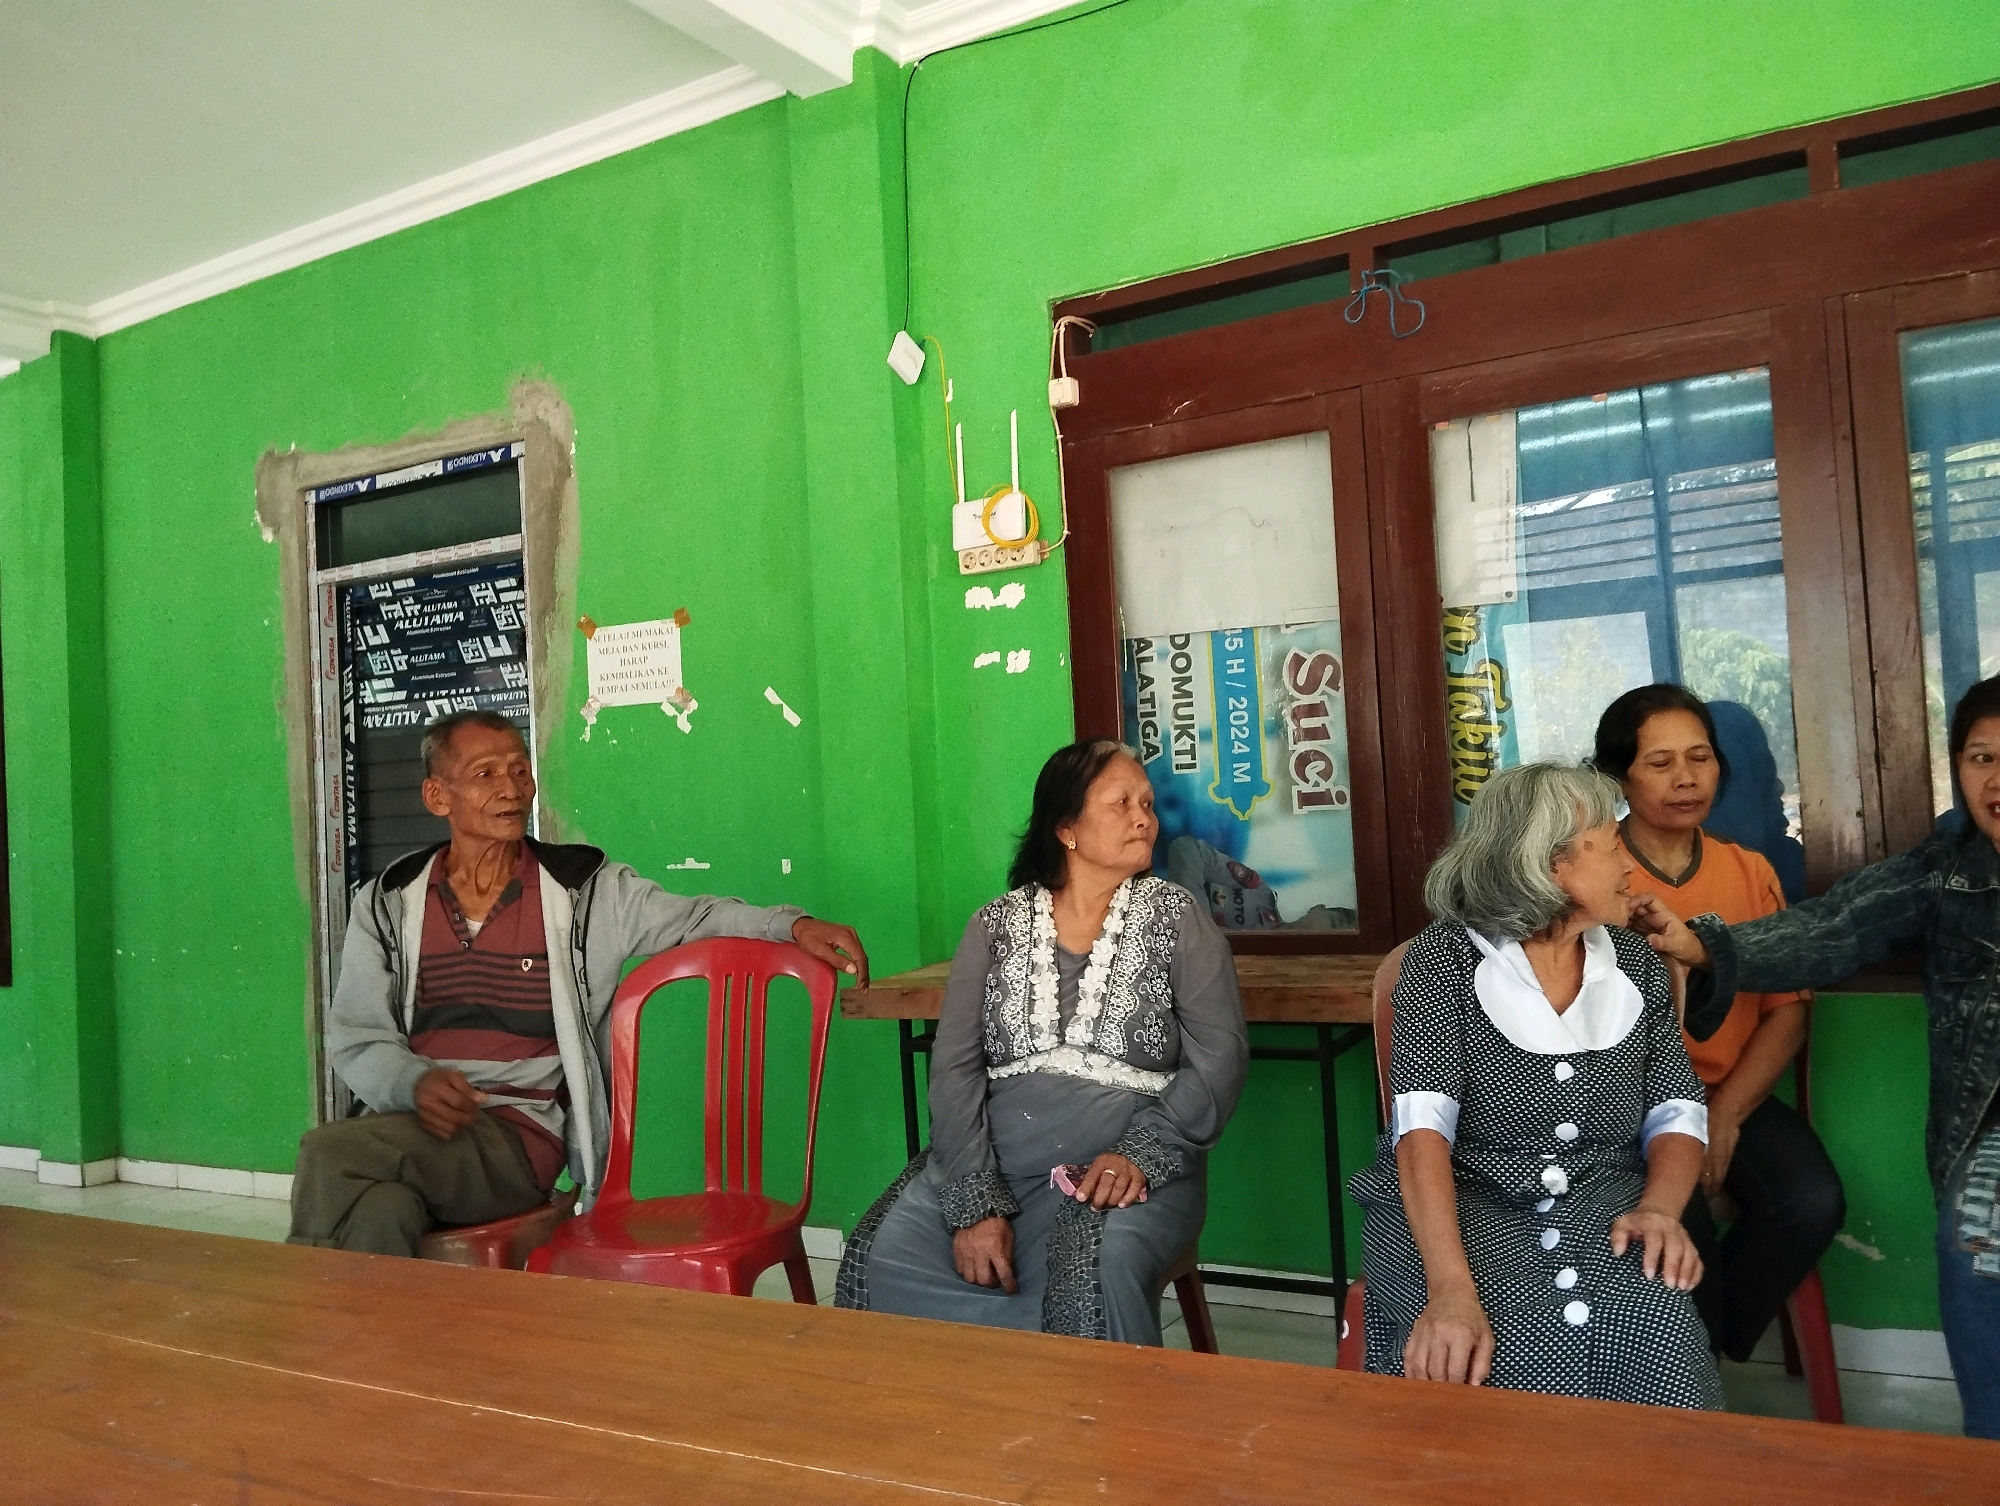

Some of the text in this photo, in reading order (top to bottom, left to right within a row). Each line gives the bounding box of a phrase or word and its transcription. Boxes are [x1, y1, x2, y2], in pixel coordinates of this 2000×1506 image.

[422, 601, 458, 613] ALUTAMA
[394, 611, 465, 630] ALUTAMA
[593, 626, 674, 643] SETELAH MEMAKAI
[328, 637, 336, 675] CONTASA
[598, 645, 621, 655] MEJA
[622, 643, 640, 653] DAN
[410, 652, 446, 664] ALUTAMA
[620, 655, 648, 667] HARAP
[1226, 658, 1246, 675] H
[600, 666, 669, 681] KEMBALIKAN KE
[596, 684, 630, 695] TEMPAT
[1227, 696, 1251, 755] 2024
[1285, 649, 1349, 811] Suci
[1232, 762, 1252, 784] M
[345, 749, 357, 848] ALUTAMA
[334, 828, 342, 866] CONTASA
